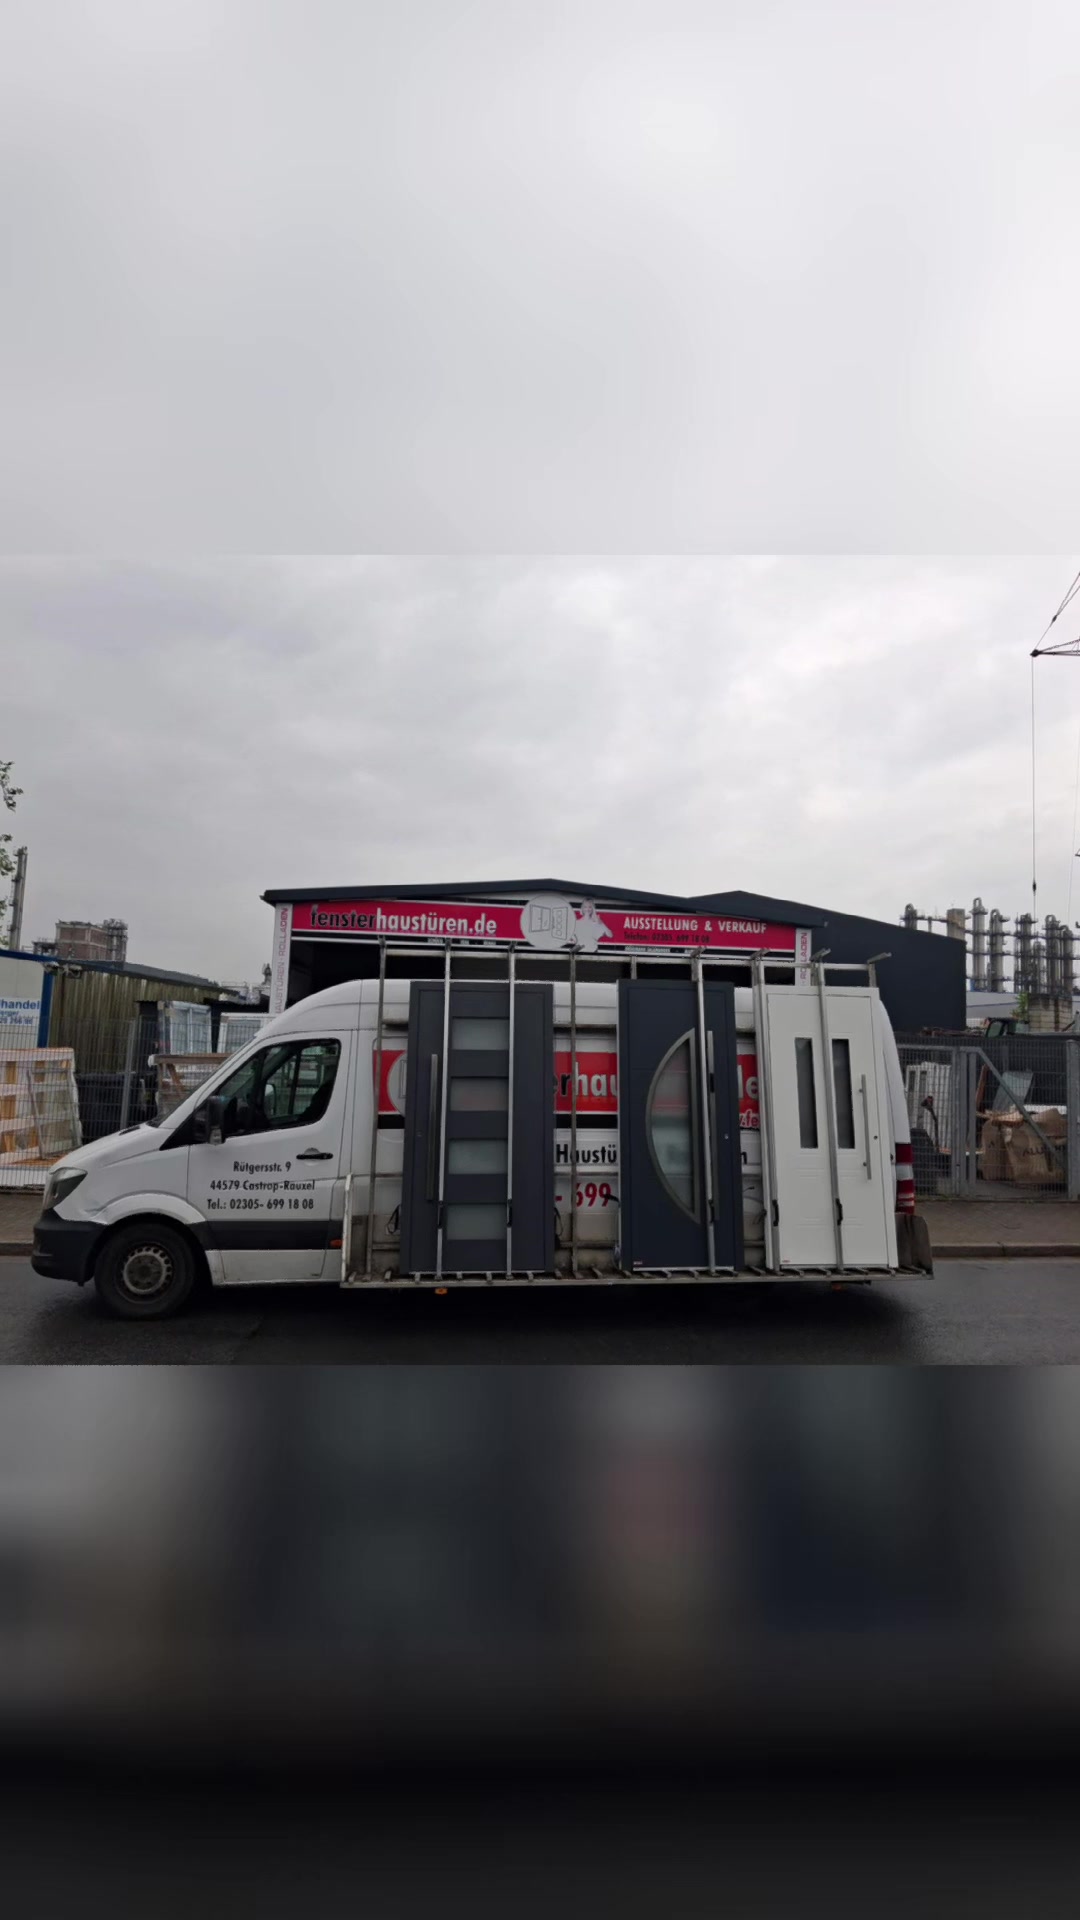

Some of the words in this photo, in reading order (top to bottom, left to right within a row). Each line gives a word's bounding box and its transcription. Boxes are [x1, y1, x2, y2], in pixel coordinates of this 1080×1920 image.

[310, 905, 498, 936] fensterhaustüren.de
[623, 916, 698, 931] AUSSTELLUNG
[704, 921, 713, 931] &
[717, 922, 768, 935] VERKAUF
[278, 907, 289, 956] ROLLADEN
[800, 932, 808, 979] ROLADEN
[233, 1160, 282, 1175] Rütgersstr.
[285, 1161, 292, 1172] 9
[210, 1180, 240, 1191] 44579
[243, 1179, 315, 1193] Castrop-Rauxel
[207, 1198, 227, 1209] Tel.:
[266, 1199, 285, 1209] 699
[288, 1199, 299, 1209] 18
[302, 1199, 314, 1209] 08
